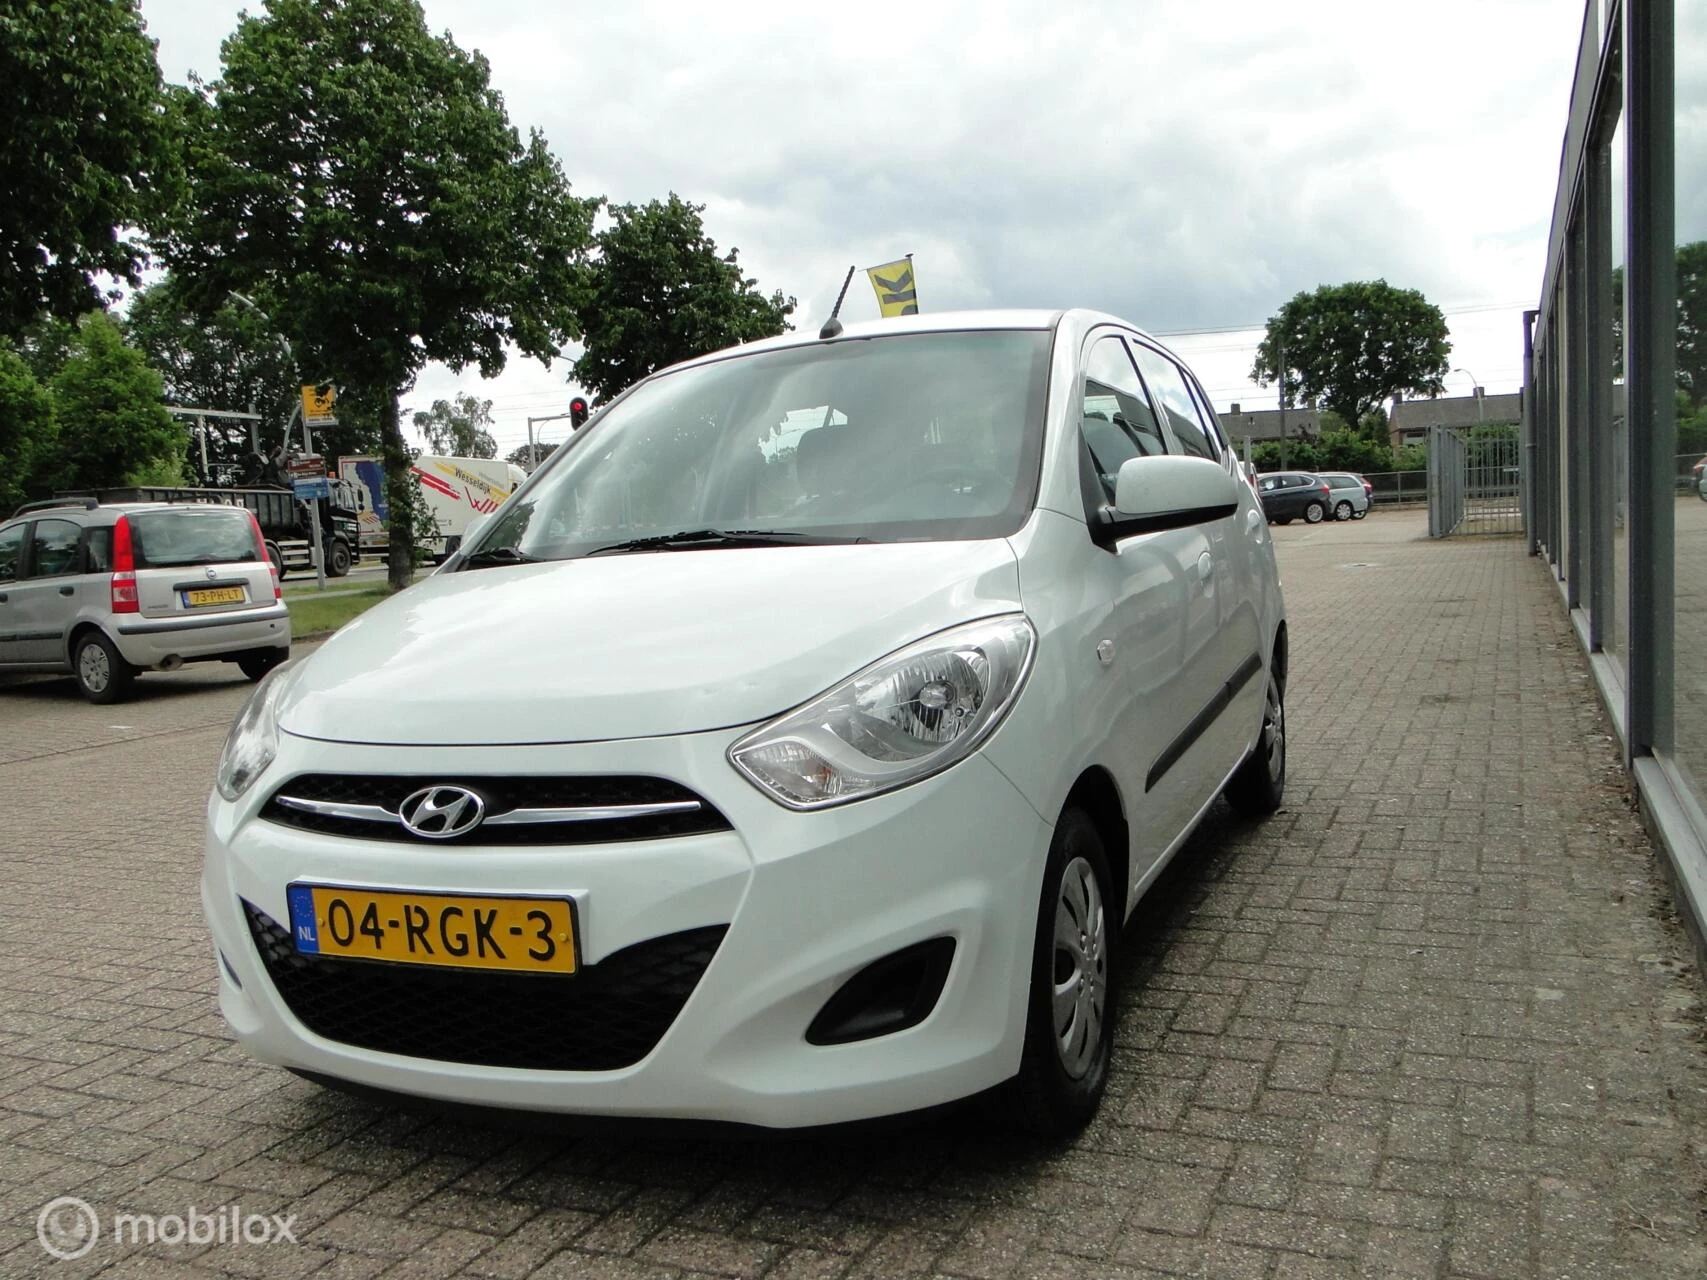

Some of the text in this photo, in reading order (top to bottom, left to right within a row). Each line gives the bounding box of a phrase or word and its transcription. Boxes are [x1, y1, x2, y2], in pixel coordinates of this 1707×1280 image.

[455, 467, 492, 495] Wesseldijk
[193, 589, 239, 602] 73-PH-LT
[298, 898, 556, 961] NL 04-RGK-3
